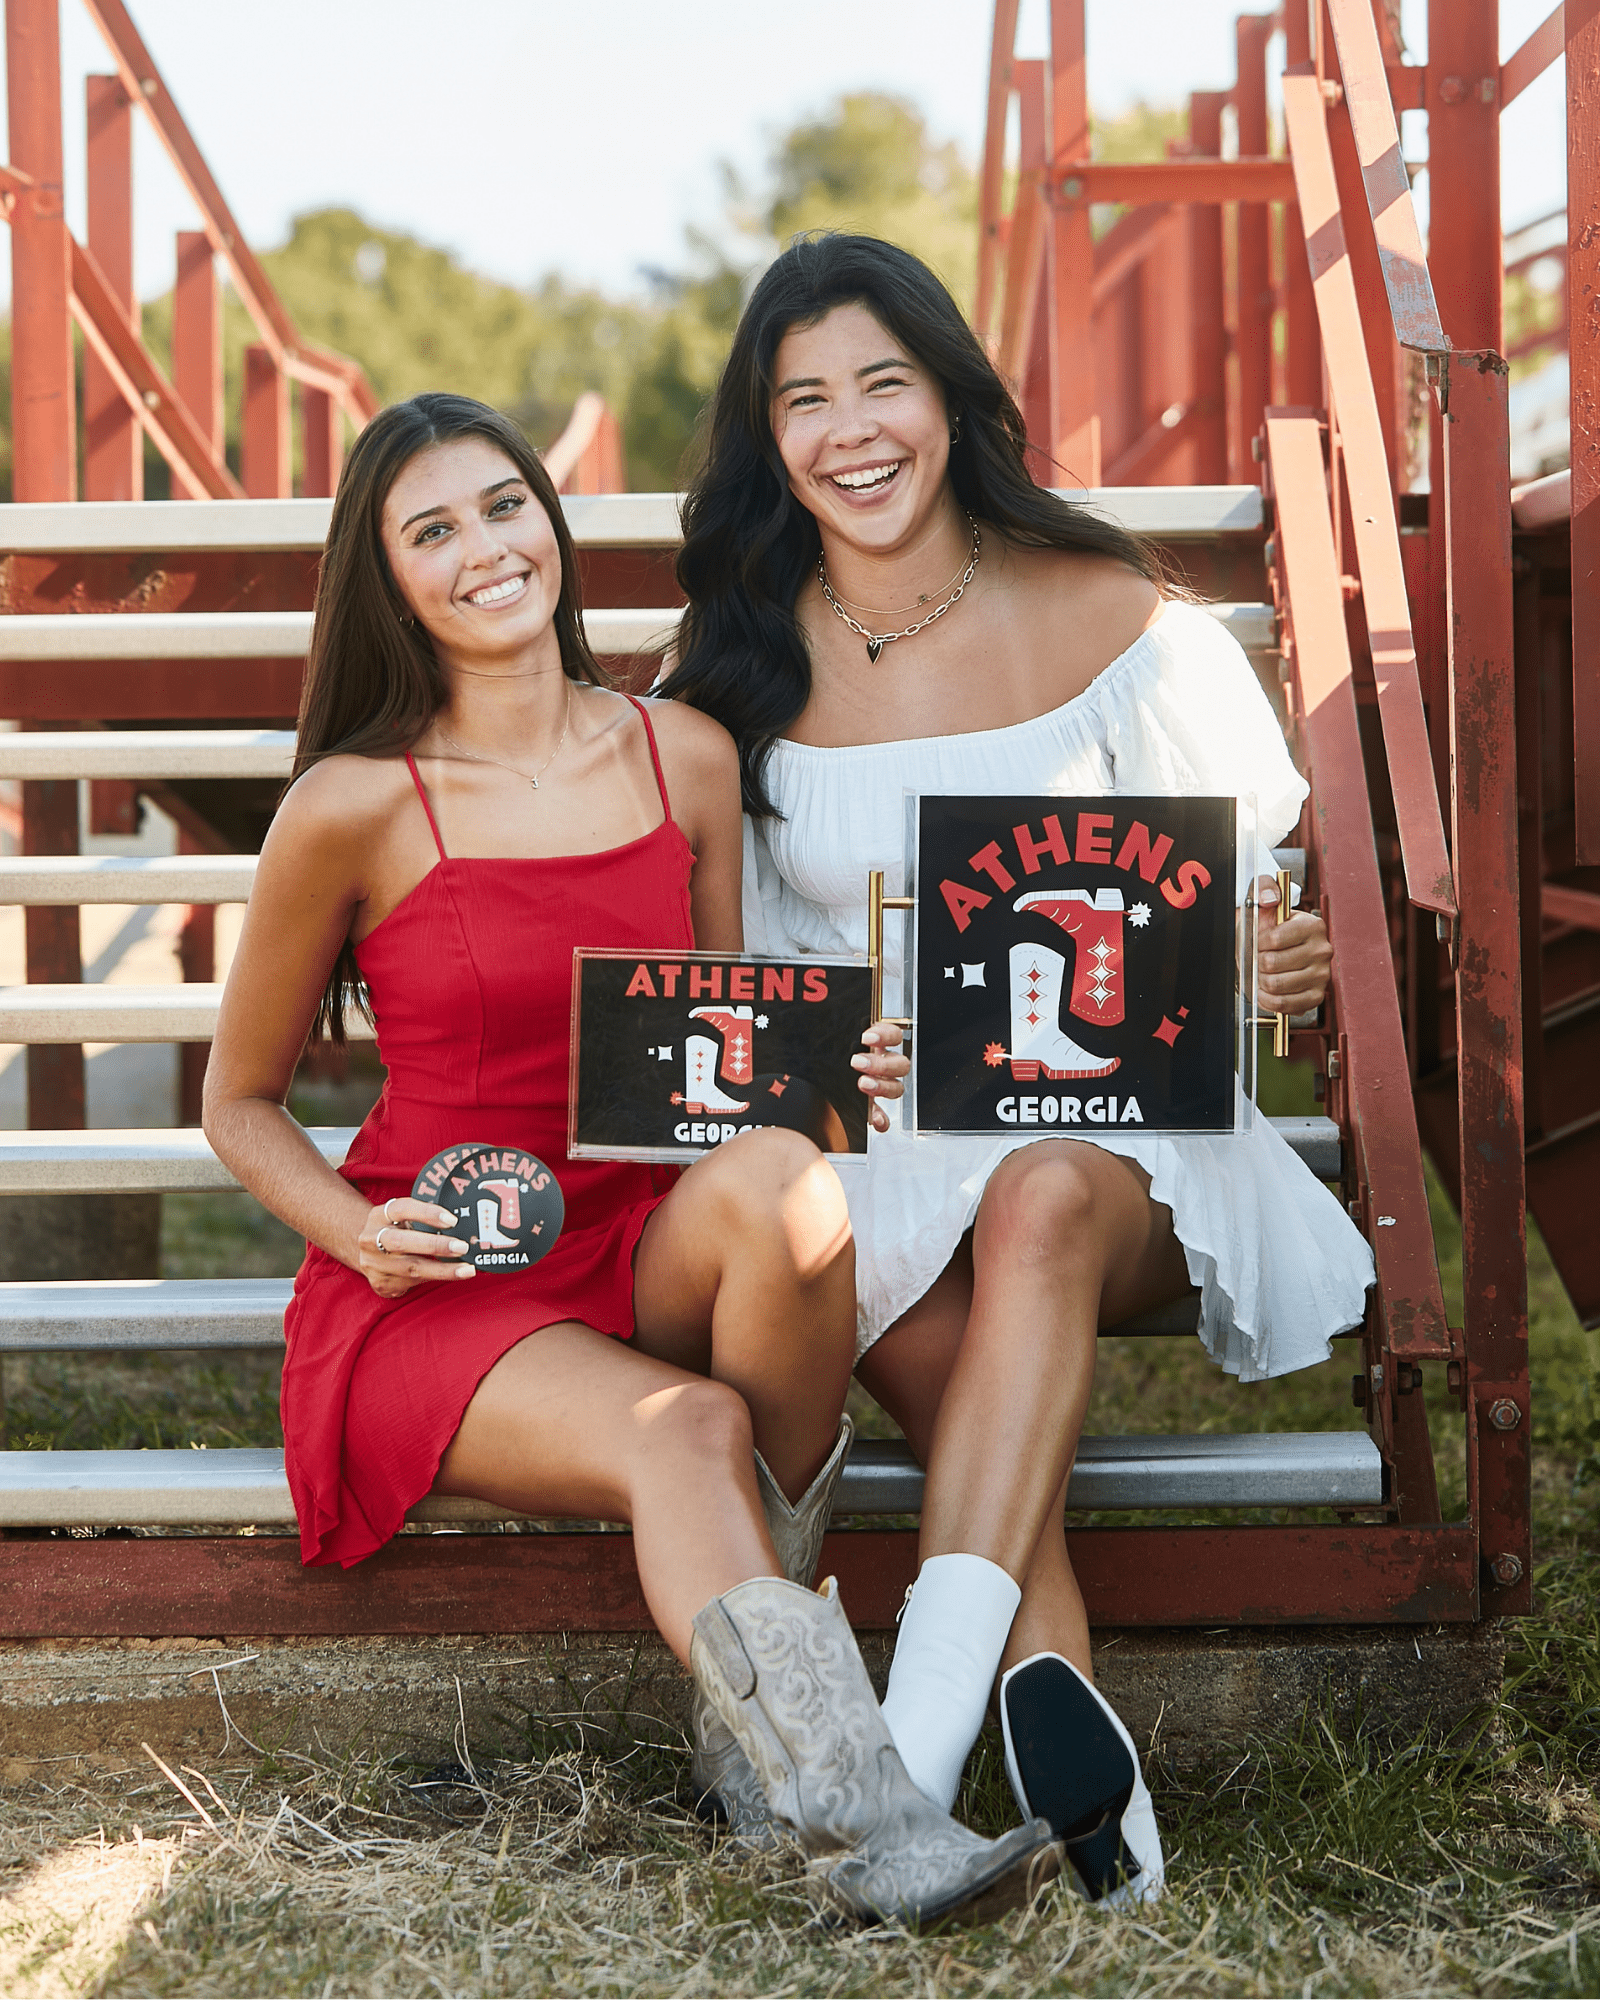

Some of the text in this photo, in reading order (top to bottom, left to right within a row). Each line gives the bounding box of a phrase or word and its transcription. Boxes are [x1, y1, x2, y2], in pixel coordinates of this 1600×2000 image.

[939, 812, 1212, 933] ATHENS
[624, 963, 829, 1002] ATHENS
[996, 1096, 1144, 1123] GEORGIA
[674, 1122, 776, 1144] GEOR
[450, 1152, 551, 1196] ATHENS
[474, 1253, 529, 1265] GEORGIA
